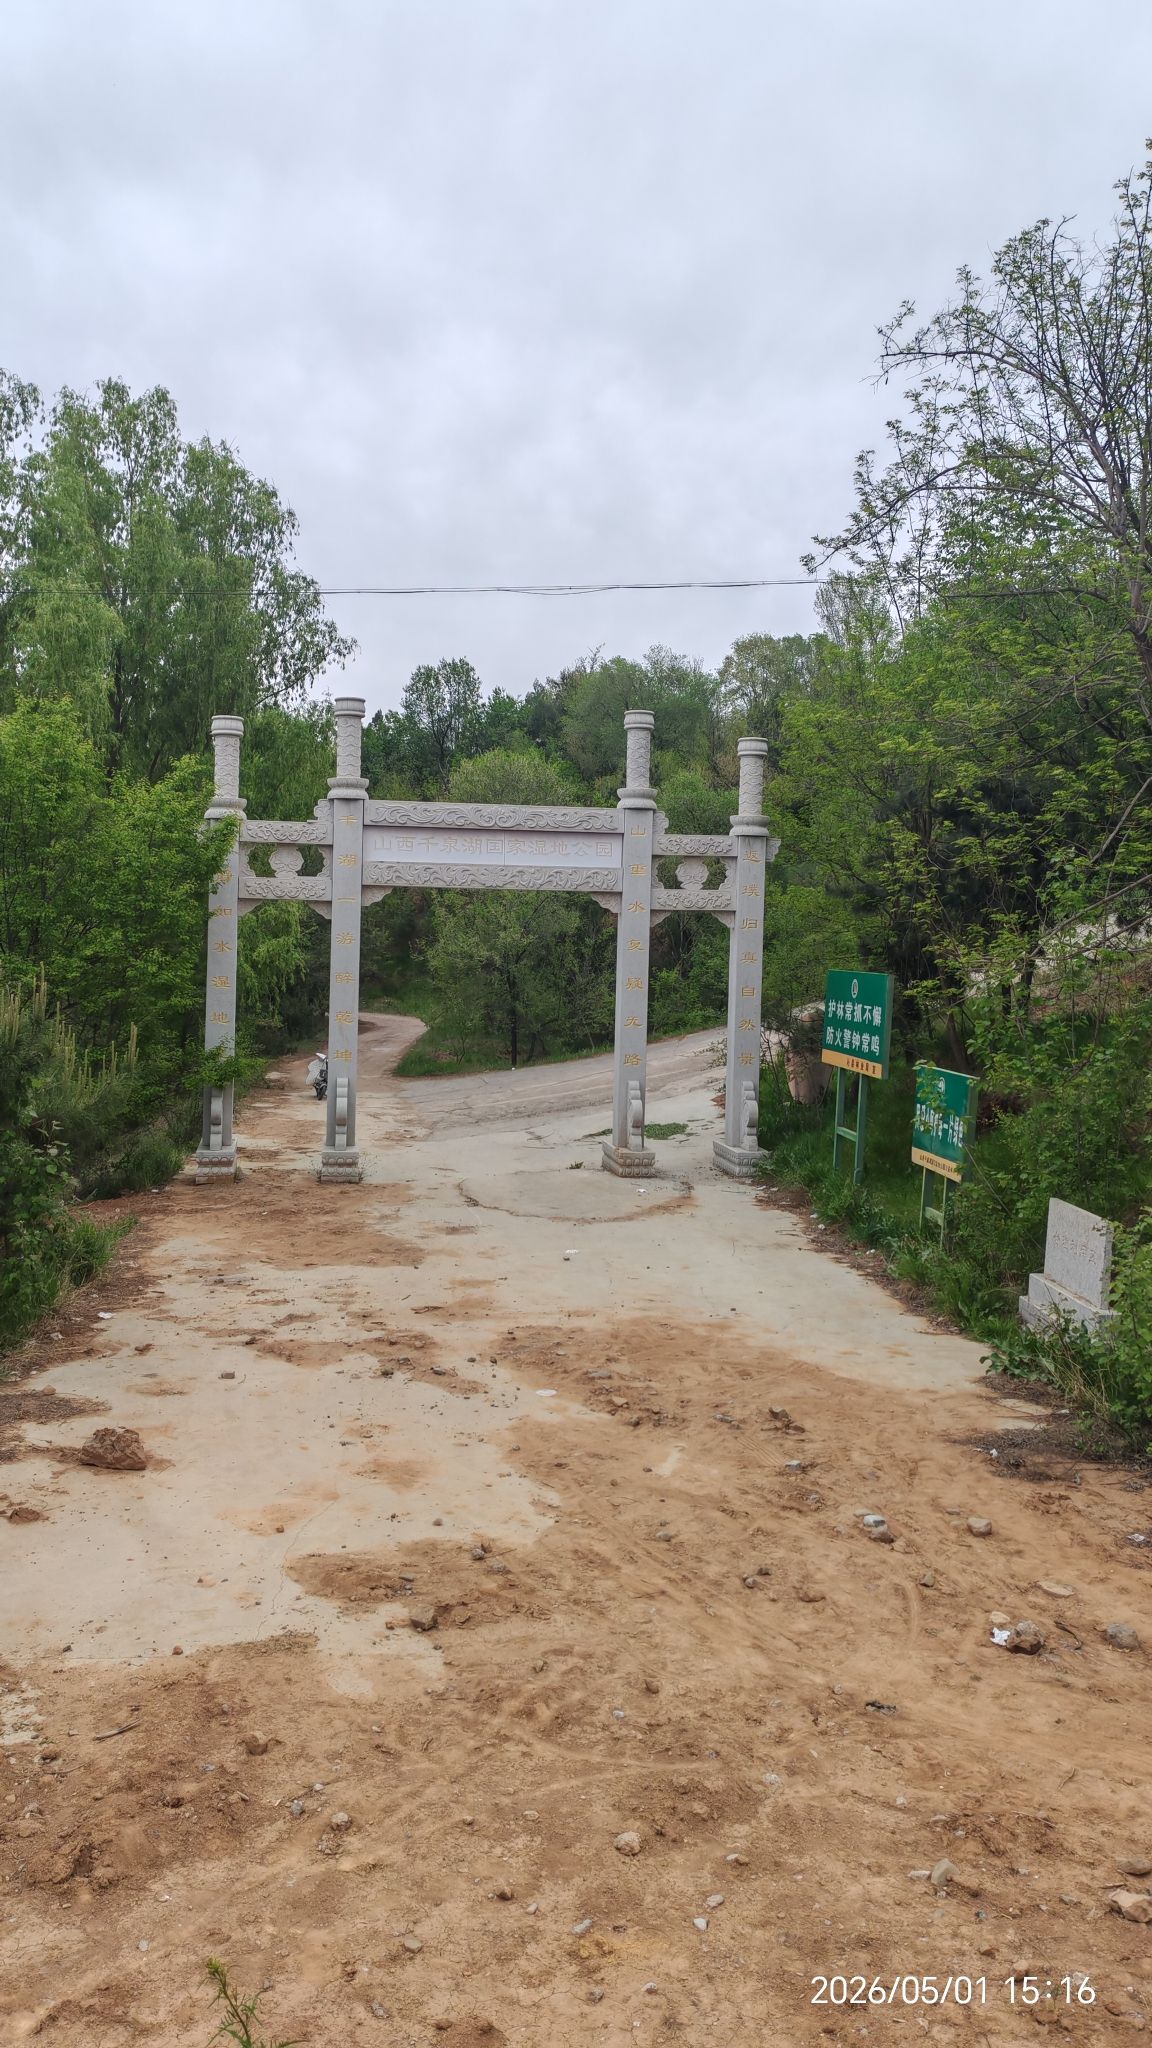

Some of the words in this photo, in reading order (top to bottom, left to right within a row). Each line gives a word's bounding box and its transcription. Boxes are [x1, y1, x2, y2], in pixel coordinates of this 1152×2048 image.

[373, 835, 613, 858] 山西千泉湖国家湿地公园
[623, 824, 646, 1066] 山重水复疑无路
[828, 999, 882, 1027] 护林常抓不懈
[825, 1026, 880, 1056] 防火警钟常鸣
